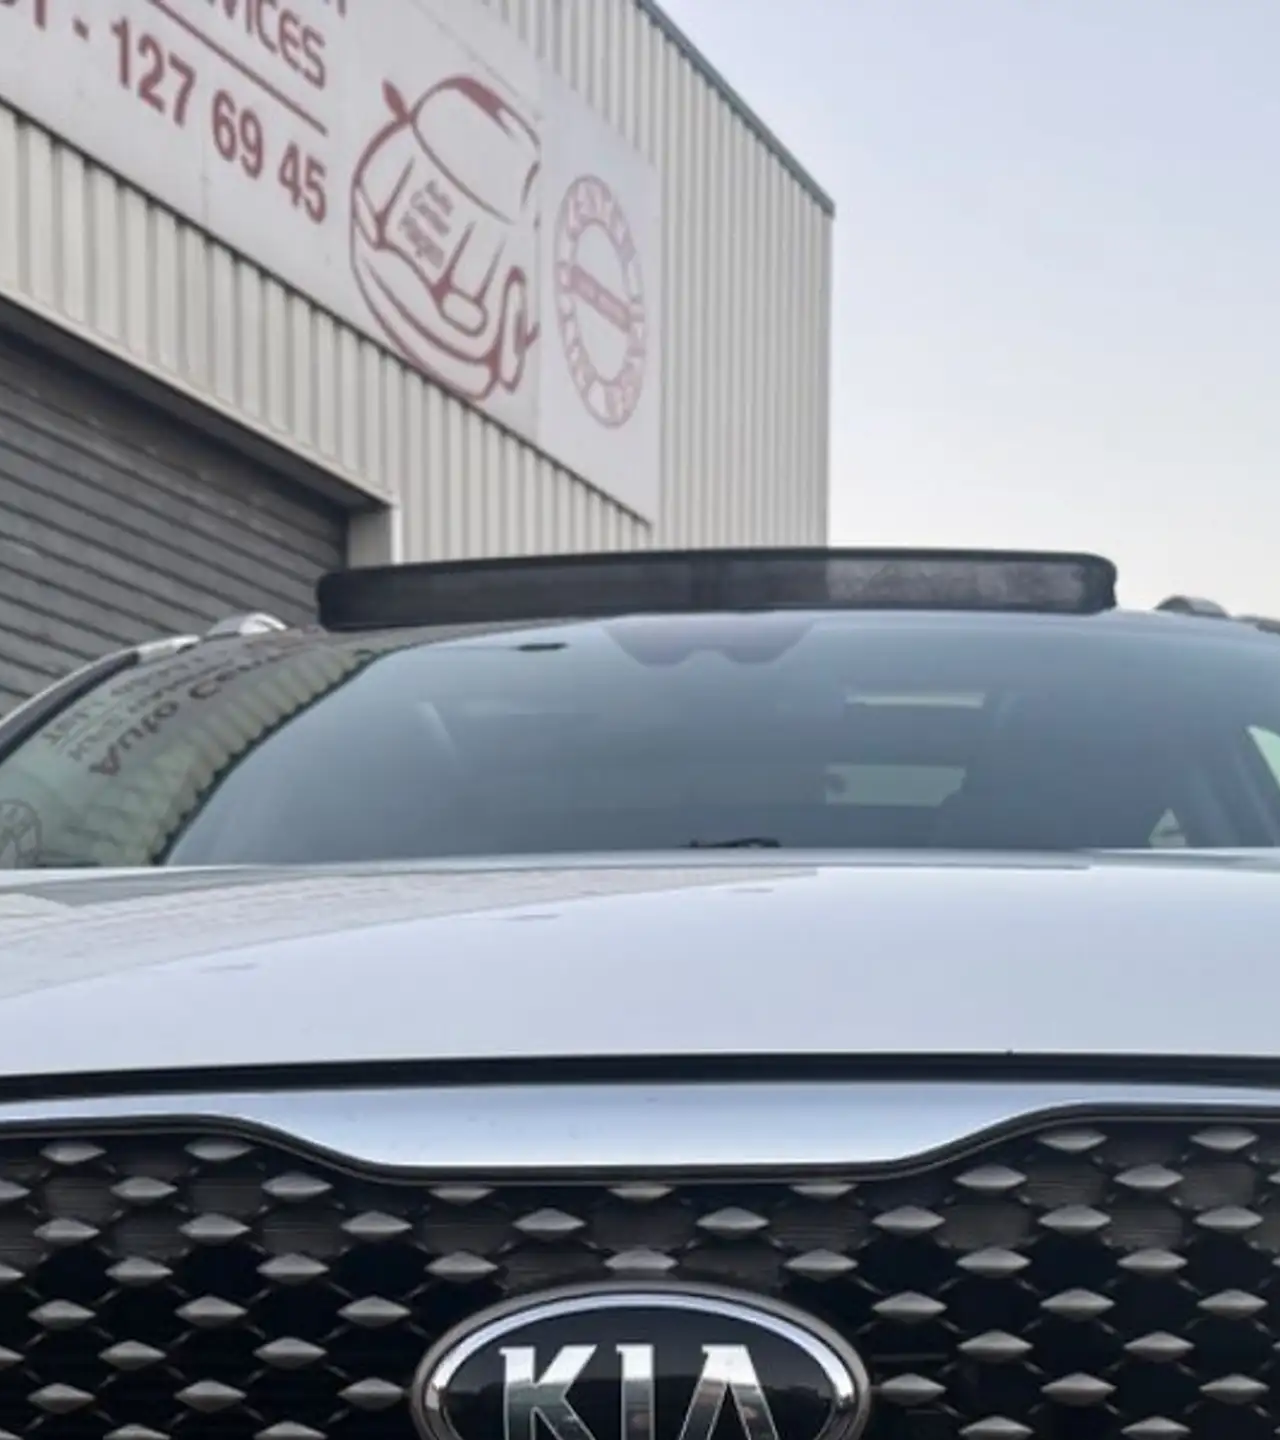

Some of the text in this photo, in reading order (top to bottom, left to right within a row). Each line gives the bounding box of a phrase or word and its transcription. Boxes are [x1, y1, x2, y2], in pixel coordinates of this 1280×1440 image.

[206, 0, 326, 90] ICES
[111, 17, 196, 128] 127
[213, 90, 263, 179] 69
[278, 142, 327, 223] 45
